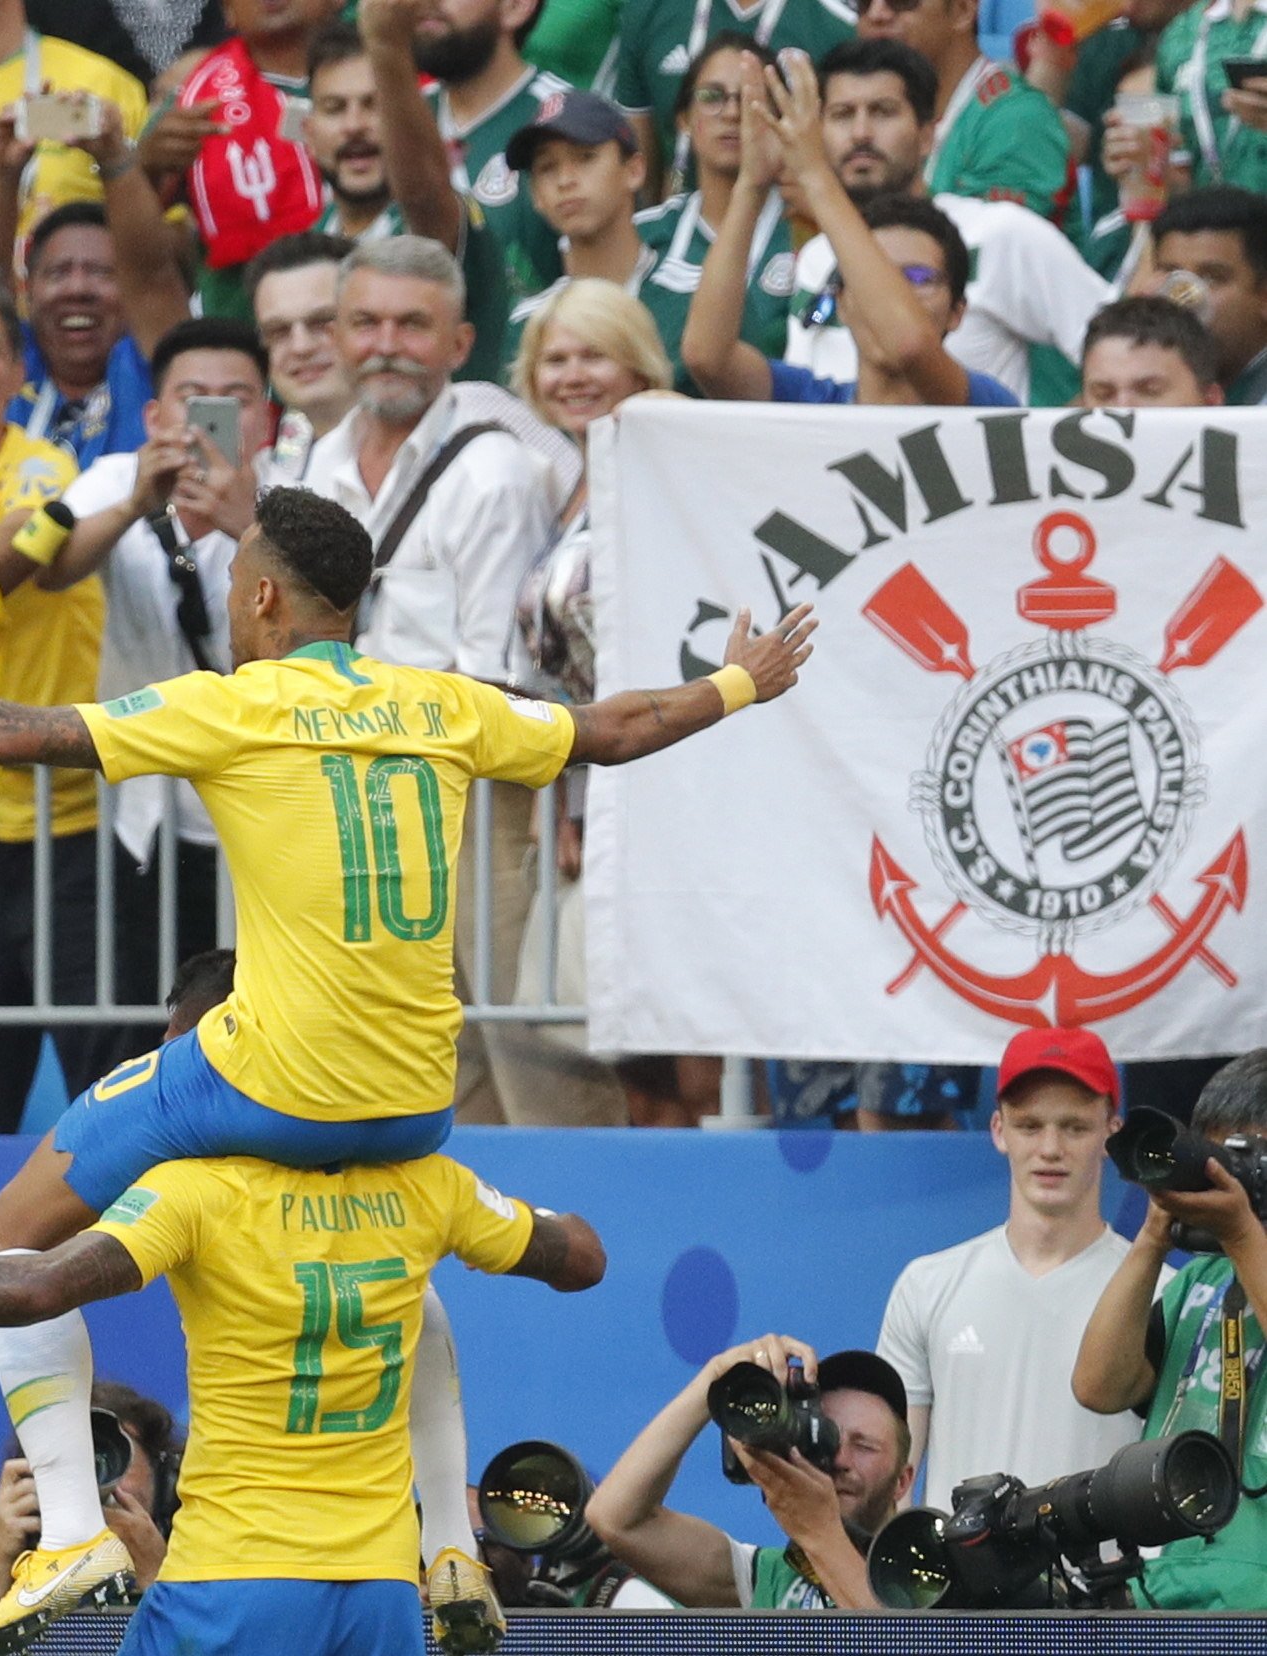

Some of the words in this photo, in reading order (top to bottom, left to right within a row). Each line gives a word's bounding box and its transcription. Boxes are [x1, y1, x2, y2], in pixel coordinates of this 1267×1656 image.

[294, 701, 408, 742] NEYMAR
[417, 700, 448, 739] JR
[944, 660, 1138, 809] CORINTHIANS
[1130, 695, 1181, 870] PAULISTA
[320, 754, 449, 942] 10
[1025, 884, 1104, 919] 1910
[287, 1257, 408, 1434] 15
